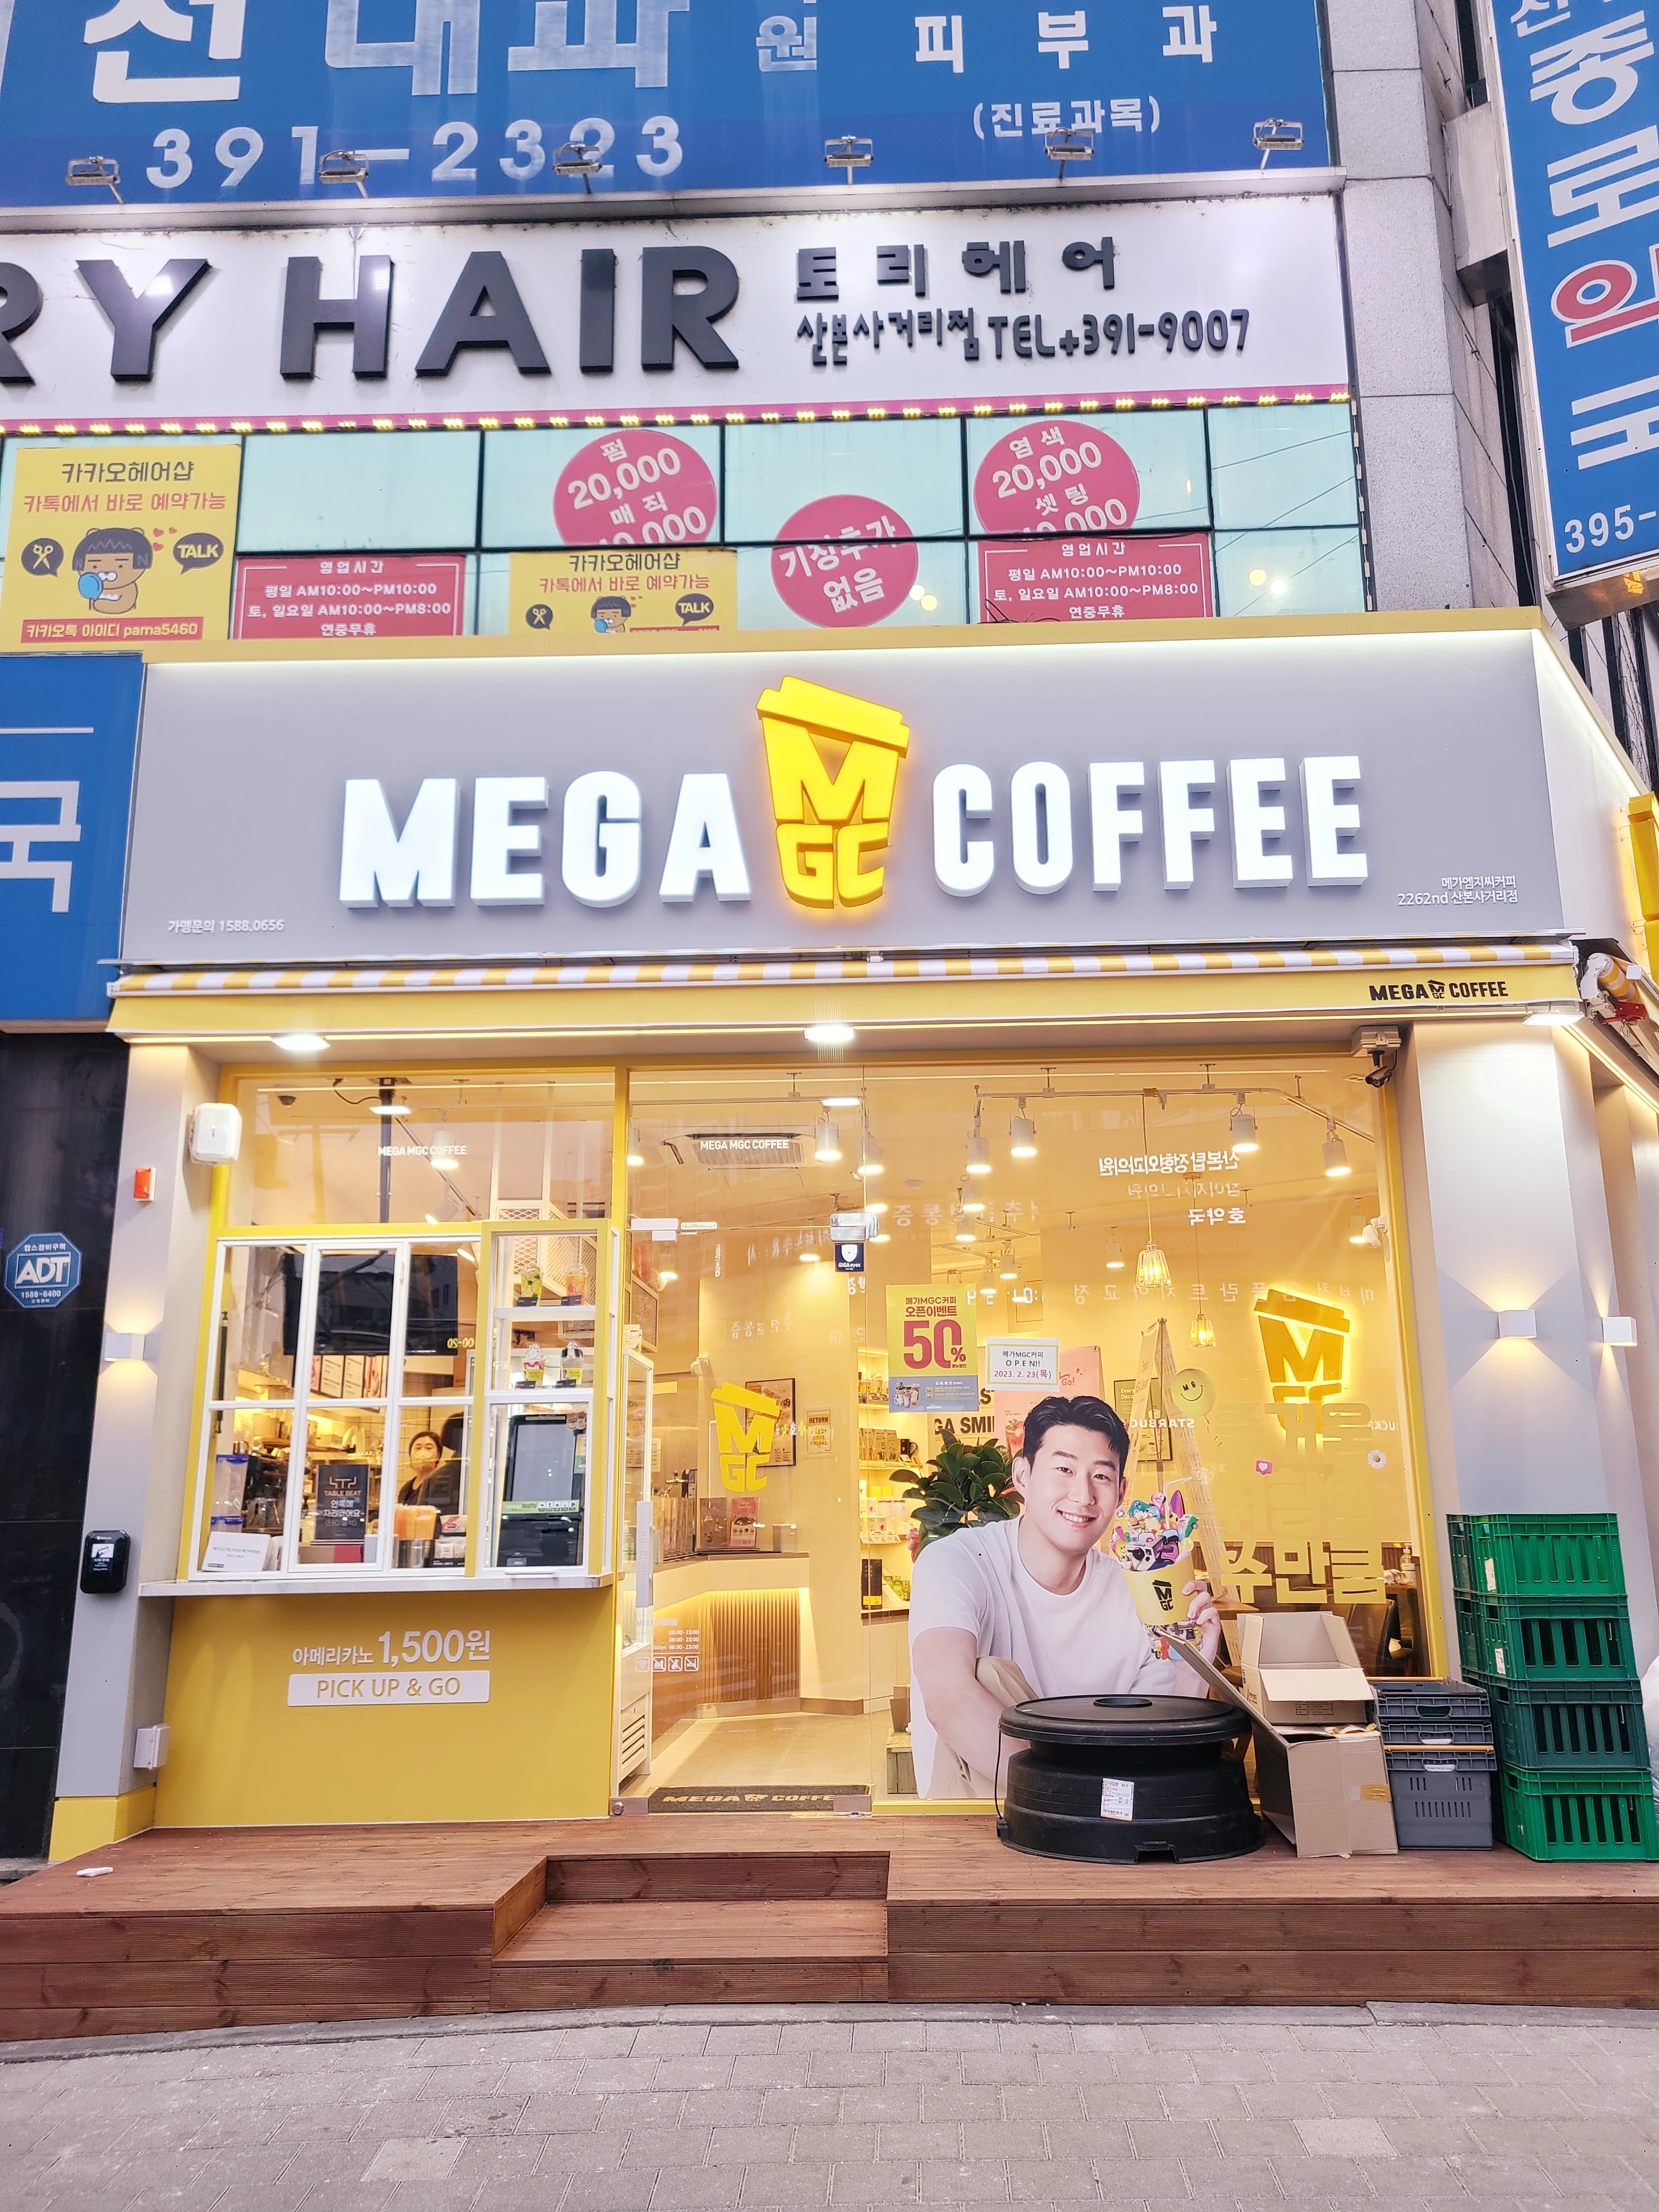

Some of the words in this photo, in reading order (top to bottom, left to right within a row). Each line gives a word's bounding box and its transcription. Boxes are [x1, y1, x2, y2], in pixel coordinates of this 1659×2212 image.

[915, 4, 1217, 74] 피부과
[973, 94, 1161, 140] (진료과목)
[796, 236, 1118, 300] 토리헤어
[279, 246, 741, 381] HAIR
[797, 307, 980, 366] 산본사거리점
[601, 438, 627, 462] 펌
[1008, 426, 1065, 460] 염색
[61, 460, 194, 484] 카카오헤어샵
[567, 447, 681, 510] 20,000
[992, 441, 1102, 499] 20,000
[23, 493, 99, 514] 카톡에서
[106, 494, 144, 512] 바로
[150, 492, 226, 512] 예약가능
[609, 491, 668, 526] 매직
[1034, 483, 1089, 517] 셋팅
[177, 543, 219, 560] TALK
[1061, 541, 1126, 556] 영업시간
[320, 560, 385, 575] 영업시간
[569, 551, 681, 573] 카카오헤어샵
[1007, 567, 1035, 582] 평일
[1040, 563, 1182, 579] AM10:00~PM10:00
[264, 584, 292, 599] 평일
[296, 583, 437, 597] AM10:00~PM10:00
[539, 577, 603, 594] 카톡에서
[609, 576, 640, 592] 바로
[646, 574, 710, 590] 예약가능
[823, 568, 885, 613] 없음
[1018, 587, 1059, 601] 일요일
[1063, 583, 1198, 599] AM10:00~PM8:00
[273, 604, 313, 618] 일요일
[317, 602, 452, 617] AM10:00~PM8:00
[678, 601, 710, 614] TALK
[1069, 603, 1125, 619] 연중무휴
[26, 623, 78, 639] 카카오톡
[81, 623, 121, 638] 아이디
[123, 622, 199, 638] pama5460
[320, 622, 377, 637] 연중무휴
[338, 769, 752, 909] MEGA
[932, 755, 1370, 898] COFFEE
[1441, 874, 1516, 890] 메가엠지씨커피
[1397, 891, 1449, 906] 2262nd
[1451, 889, 1519, 905] 산본사거리점
[167, 919, 216, 934] 가맹문의
[219, 919, 285, 932] 1588.0656
[1369, 984, 1430, 1001] MEGA
[1448, 981, 1509, 998] COFFEE
[377, 1146, 405, 1156] MEGA
[406, 1145, 429, 1156] MGC
[430, 1144, 467, 1155] COFFEE
[699, 1140, 729, 1151] MEGA
[729, 1139, 751, 1150] MGC
[752, 1139, 789, 1150] COFFEE
[16, 1256, 71, 1284] ADT
[905, 1296, 957, 1305] 메가MGC커피
[905, 1306, 957, 1318] 오픈이벤트
[1026, 1369, 1052, 1379] 23(목)
[1062, 1376, 1075, 1386] Go!
[960, 1415, 995, 1433] SMI
[292, 1646, 374, 1666] 아메리카노
[316, 1678, 364, 1699] PICK
[371, 1679, 400, 1698] UP
[406, 1678, 422, 1696] &
[428, 1677, 461, 1696] GO
